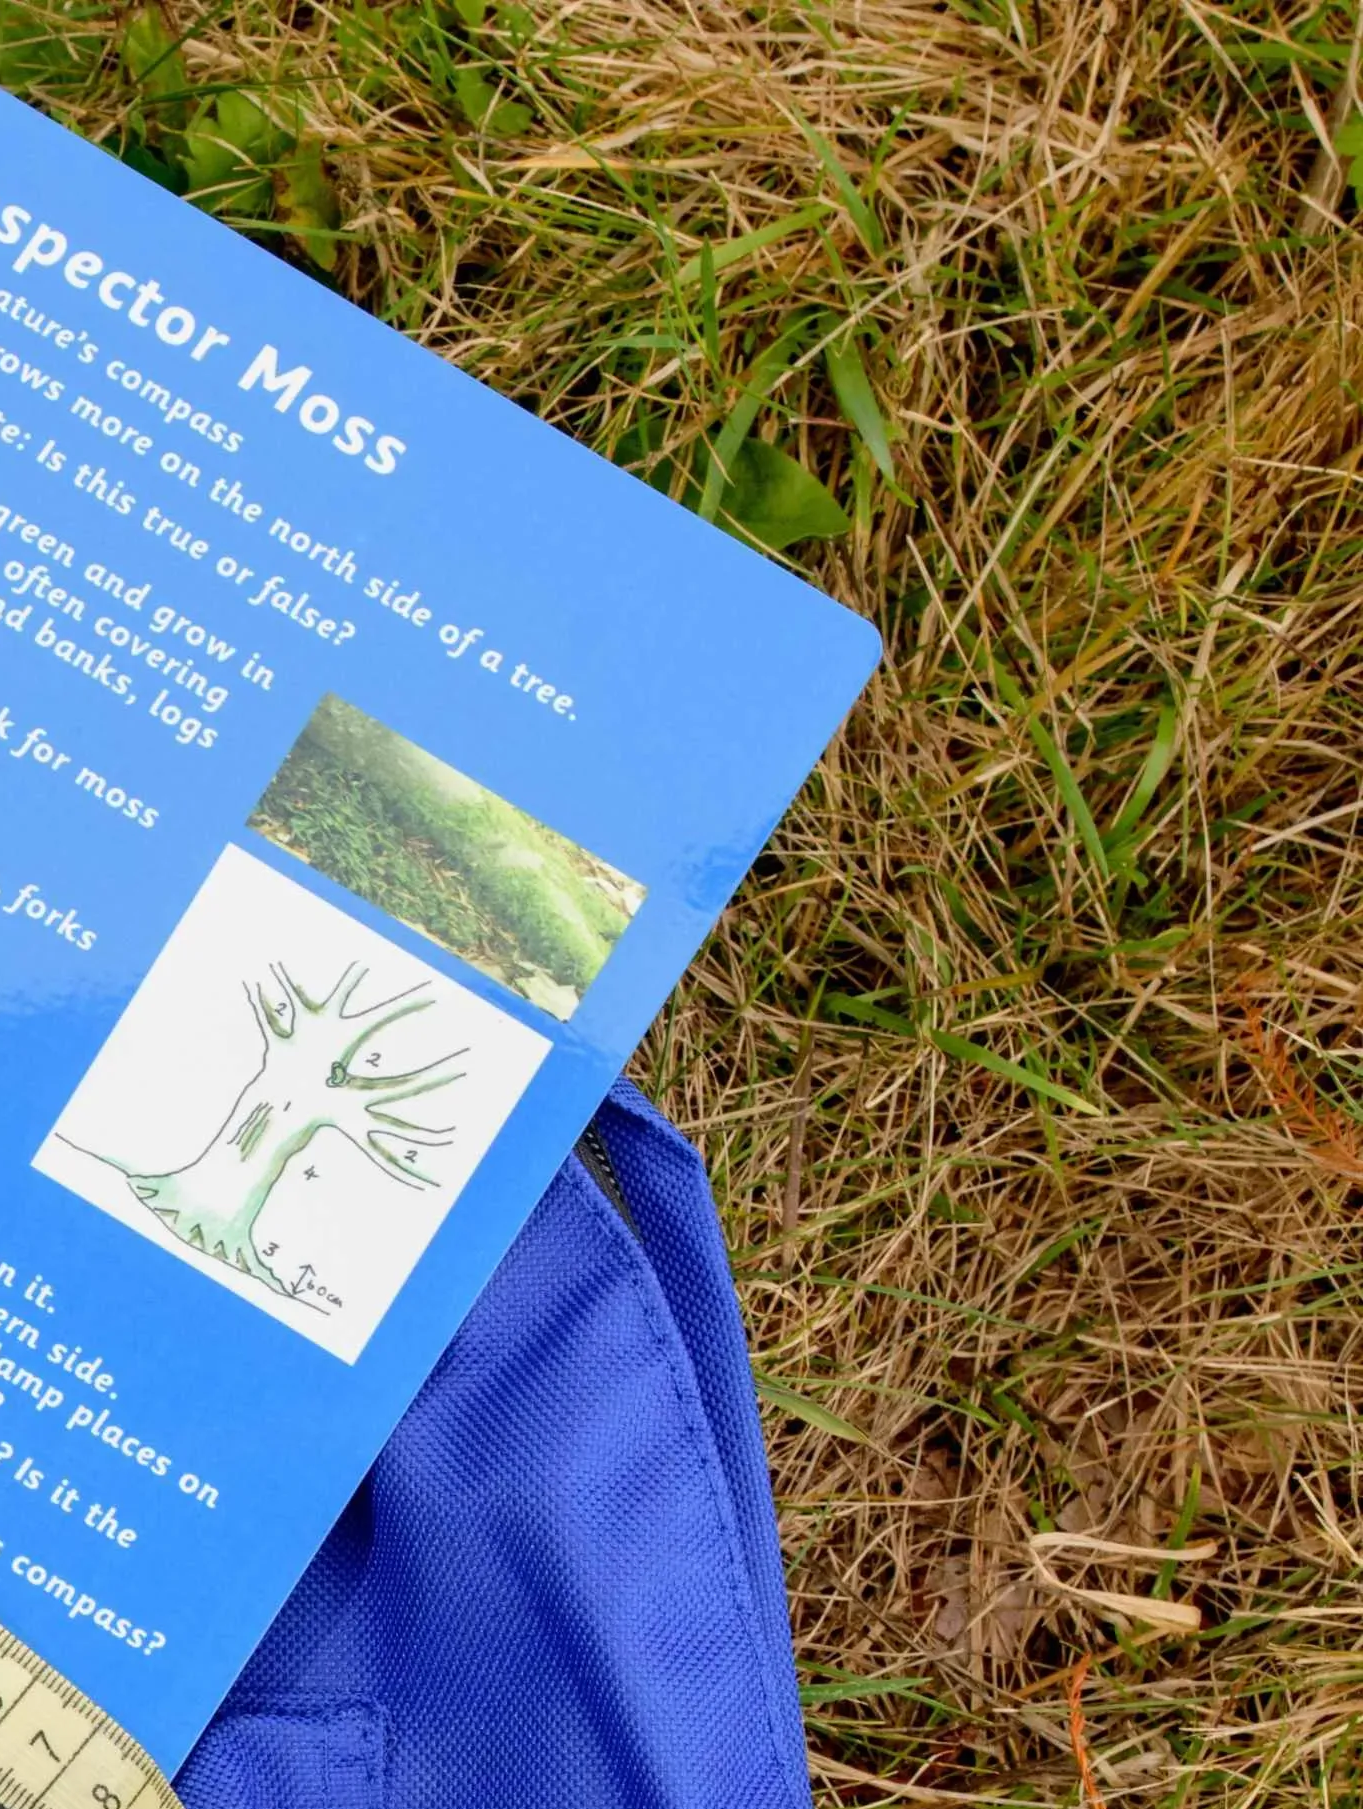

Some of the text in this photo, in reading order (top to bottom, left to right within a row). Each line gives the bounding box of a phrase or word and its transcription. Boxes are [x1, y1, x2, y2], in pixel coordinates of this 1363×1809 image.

[105, 359, 244, 453] compass
[237, 343, 408, 476] Moss
[36, 438, 67, 473] Is
[73, 463, 137, 515] this
[142, 506, 210, 560] true
[215, 556, 255, 585] or
[247, 575, 358, 643] false?
[70, 395, 154, 456] more
[159, 451, 202, 488] on
[209, 477, 263, 523] the
[268, 517, 358, 584] north
[363, 577, 433, 627] side
[438, 623, 485, 659] of
[479, 649, 504, 674] a
[509, 665, 578, 722] tree.
[27, 1728, 61, 1764] 7
